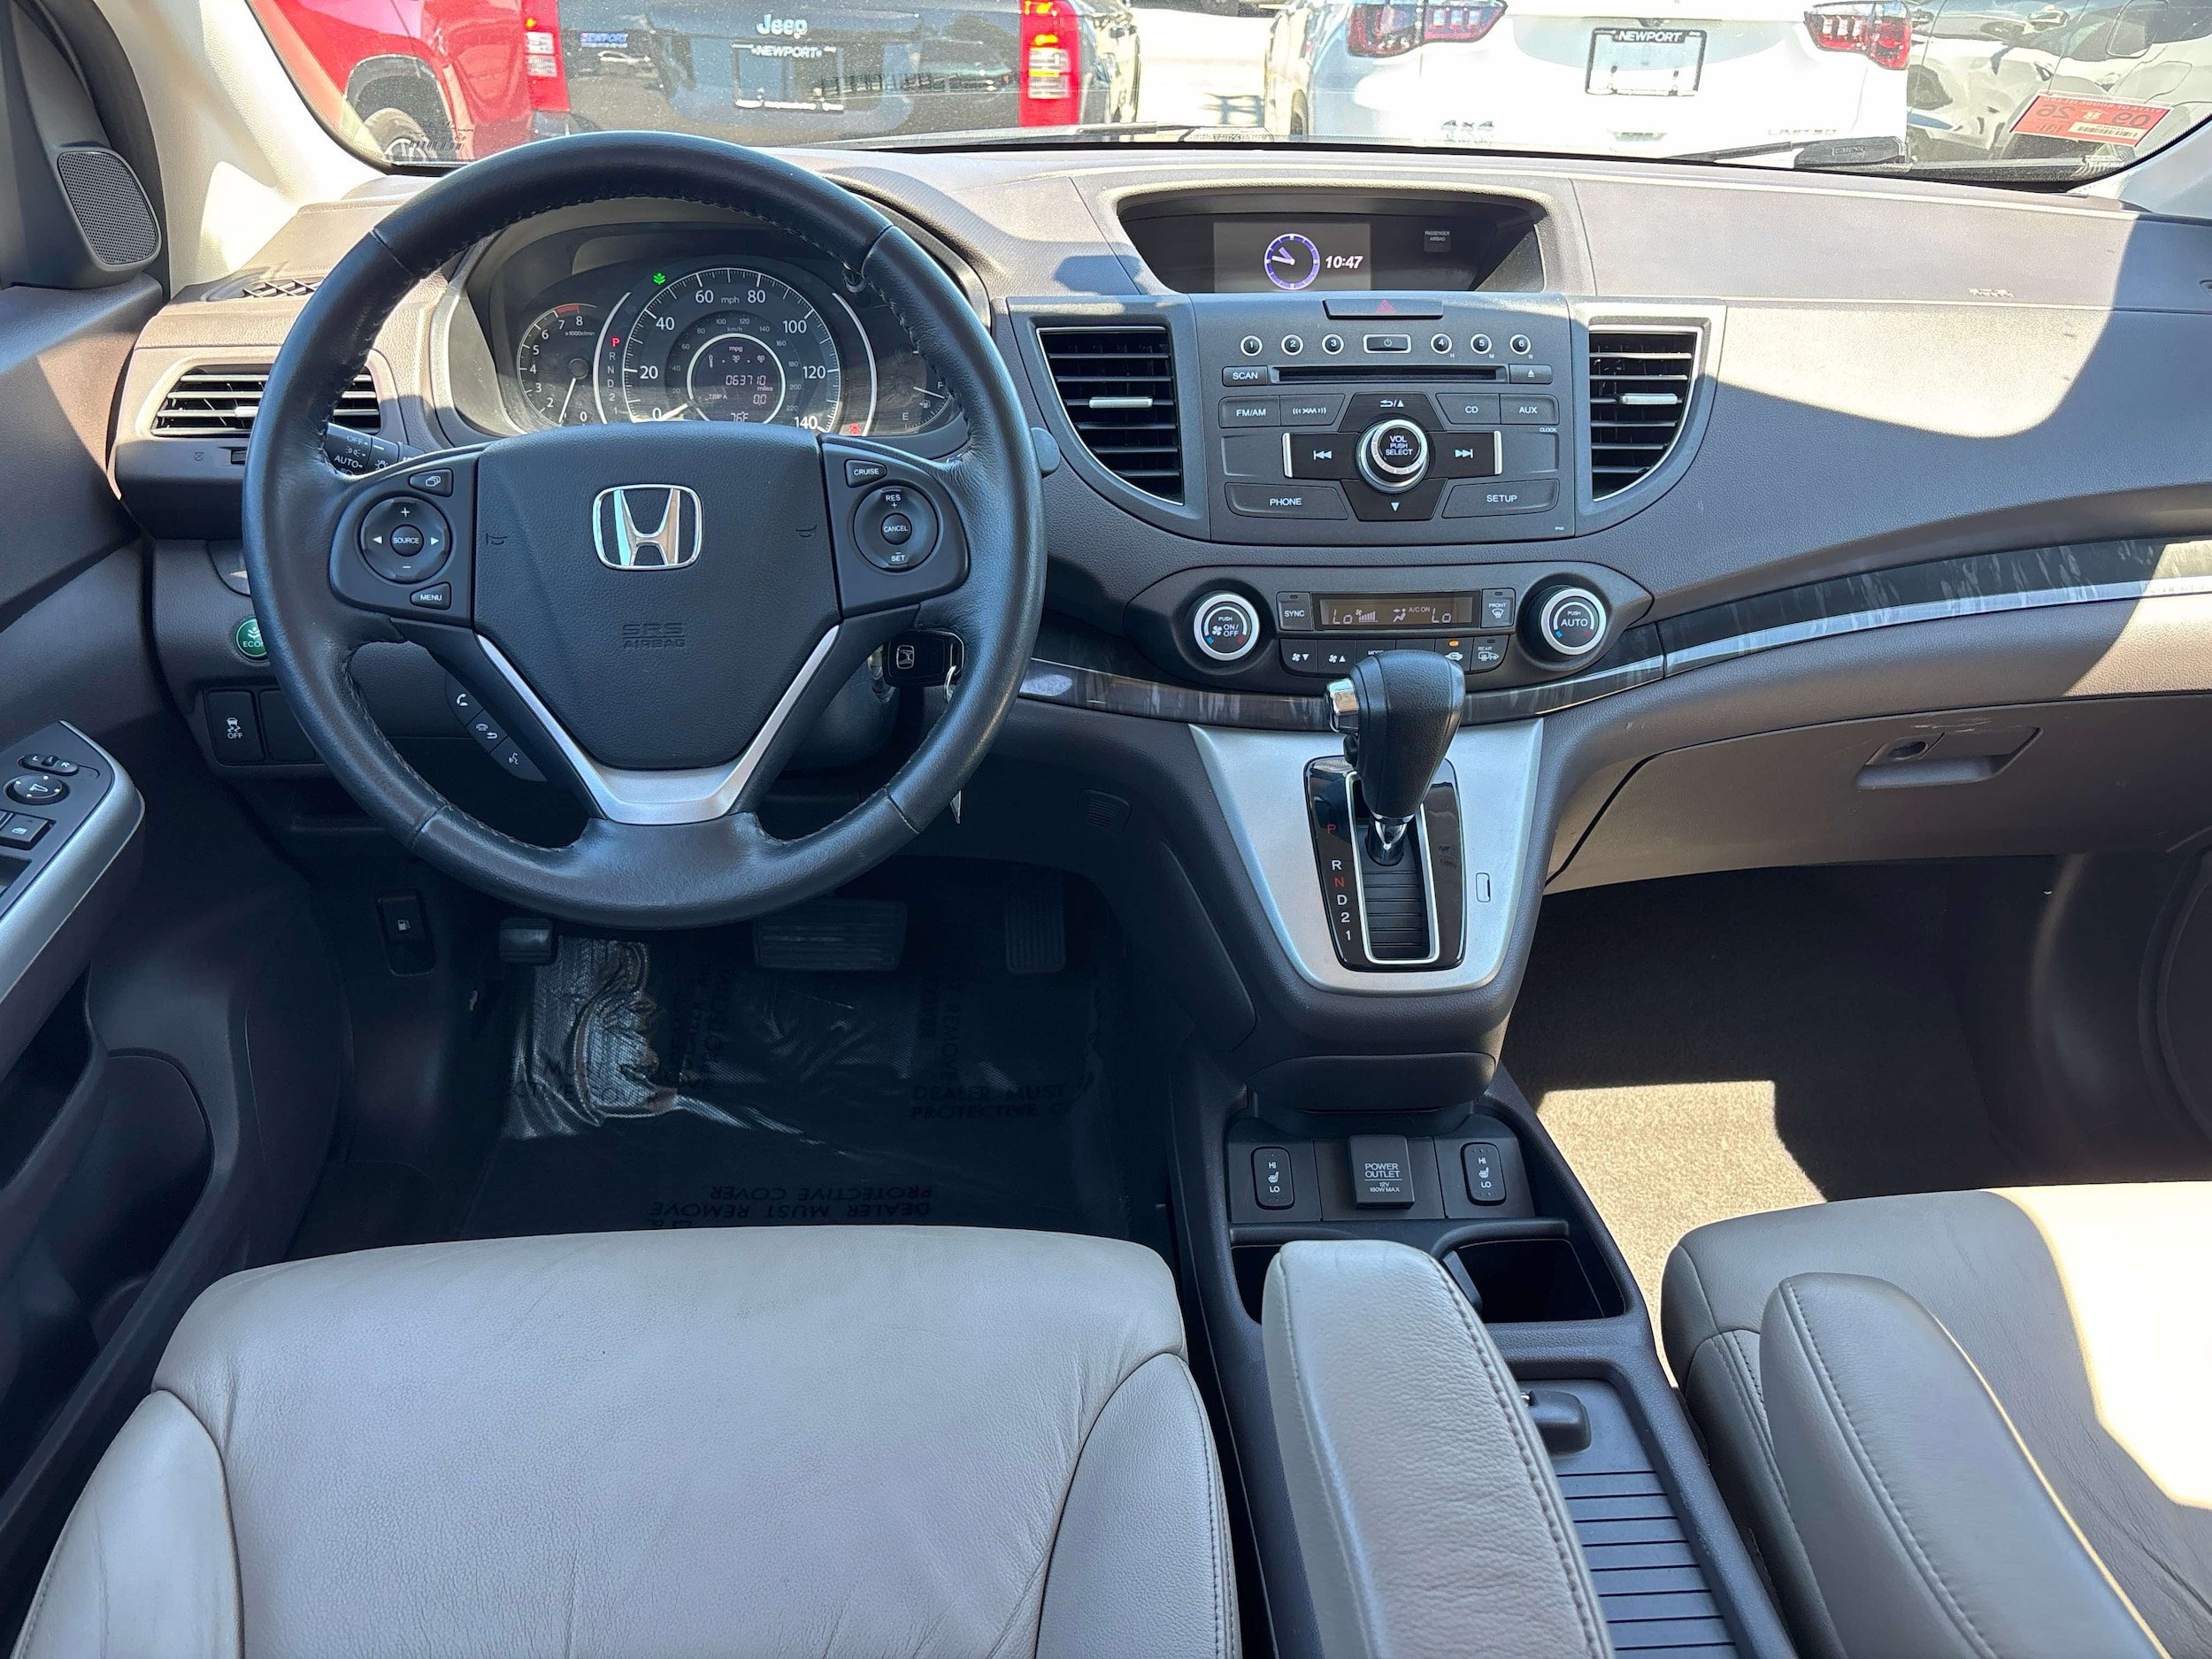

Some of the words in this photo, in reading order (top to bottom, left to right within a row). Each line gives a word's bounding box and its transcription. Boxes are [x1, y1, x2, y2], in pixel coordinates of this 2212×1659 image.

[756, 13, 808, 35] Jeep
[1617, 31, 1683, 42] NEWPORT
[755, 45, 818, 58] NEWPORT
[1325, 255, 1363, 269] 10:47
[695, 289, 714, 303] 60
[721, 296, 740, 305] mph
[748, 289, 766, 303] 80
[558, 319, 565, 330] 7
[576, 316, 583, 326] 8
[656, 317, 675, 330] 40
[783, 320, 807, 334] 100
[541, 330, 549, 340] 6
[611, 338, 620, 347] P
[533, 345, 540, 355] 5
[530, 365, 537, 374] 4
[607, 365, 615, 374] N
[640, 365, 658, 379] 20
[803, 365, 826, 379] 120
[726, 375, 766, 386] 063710
[1232, 372, 1258, 380] SCAN
[535, 383, 542, 393] 3
[547, 398, 554, 408] 2
[580, 411, 588, 422] 0
[652, 408, 662, 420] 0
[1236, 408, 1266, 417] FM/AM
[795, 416, 818, 430] 140
[346, 434, 364, 444] OFF
[1389, 434, 1407, 443] VOL
[334, 454, 358, 468] AUTO
[854, 467, 879, 476] CRUISE
[1269, 497, 1302, 506] PHONE
[1486, 494, 1517, 503] SETUP
[393, 536, 419, 545] SOURCE
[1332, 609, 1353, 625] Lo
[1431, 607, 1451, 624] Lo
[1561, 618, 1588, 627] AUTO
[622, 622, 684, 635] SRS
[623, 639, 686, 649] AIRBAG
[1327, 824, 1336, 833] P
[1332, 860, 1342, 871] R
[1334, 877, 1345, 887] N
[1337, 895, 1348, 906] D
[1340, 912, 1350, 923] 2
[1345, 931, 1351, 941] 1
[710, 1185, 788, 1202] COVER
[797, 1185, 933, 1202] PROTECTIVE
[649, 1201, 751, 1218] REMOVE
[764, 1203, 831, 1218] MUST
[847, 1202, 932, 1217] DEALER
